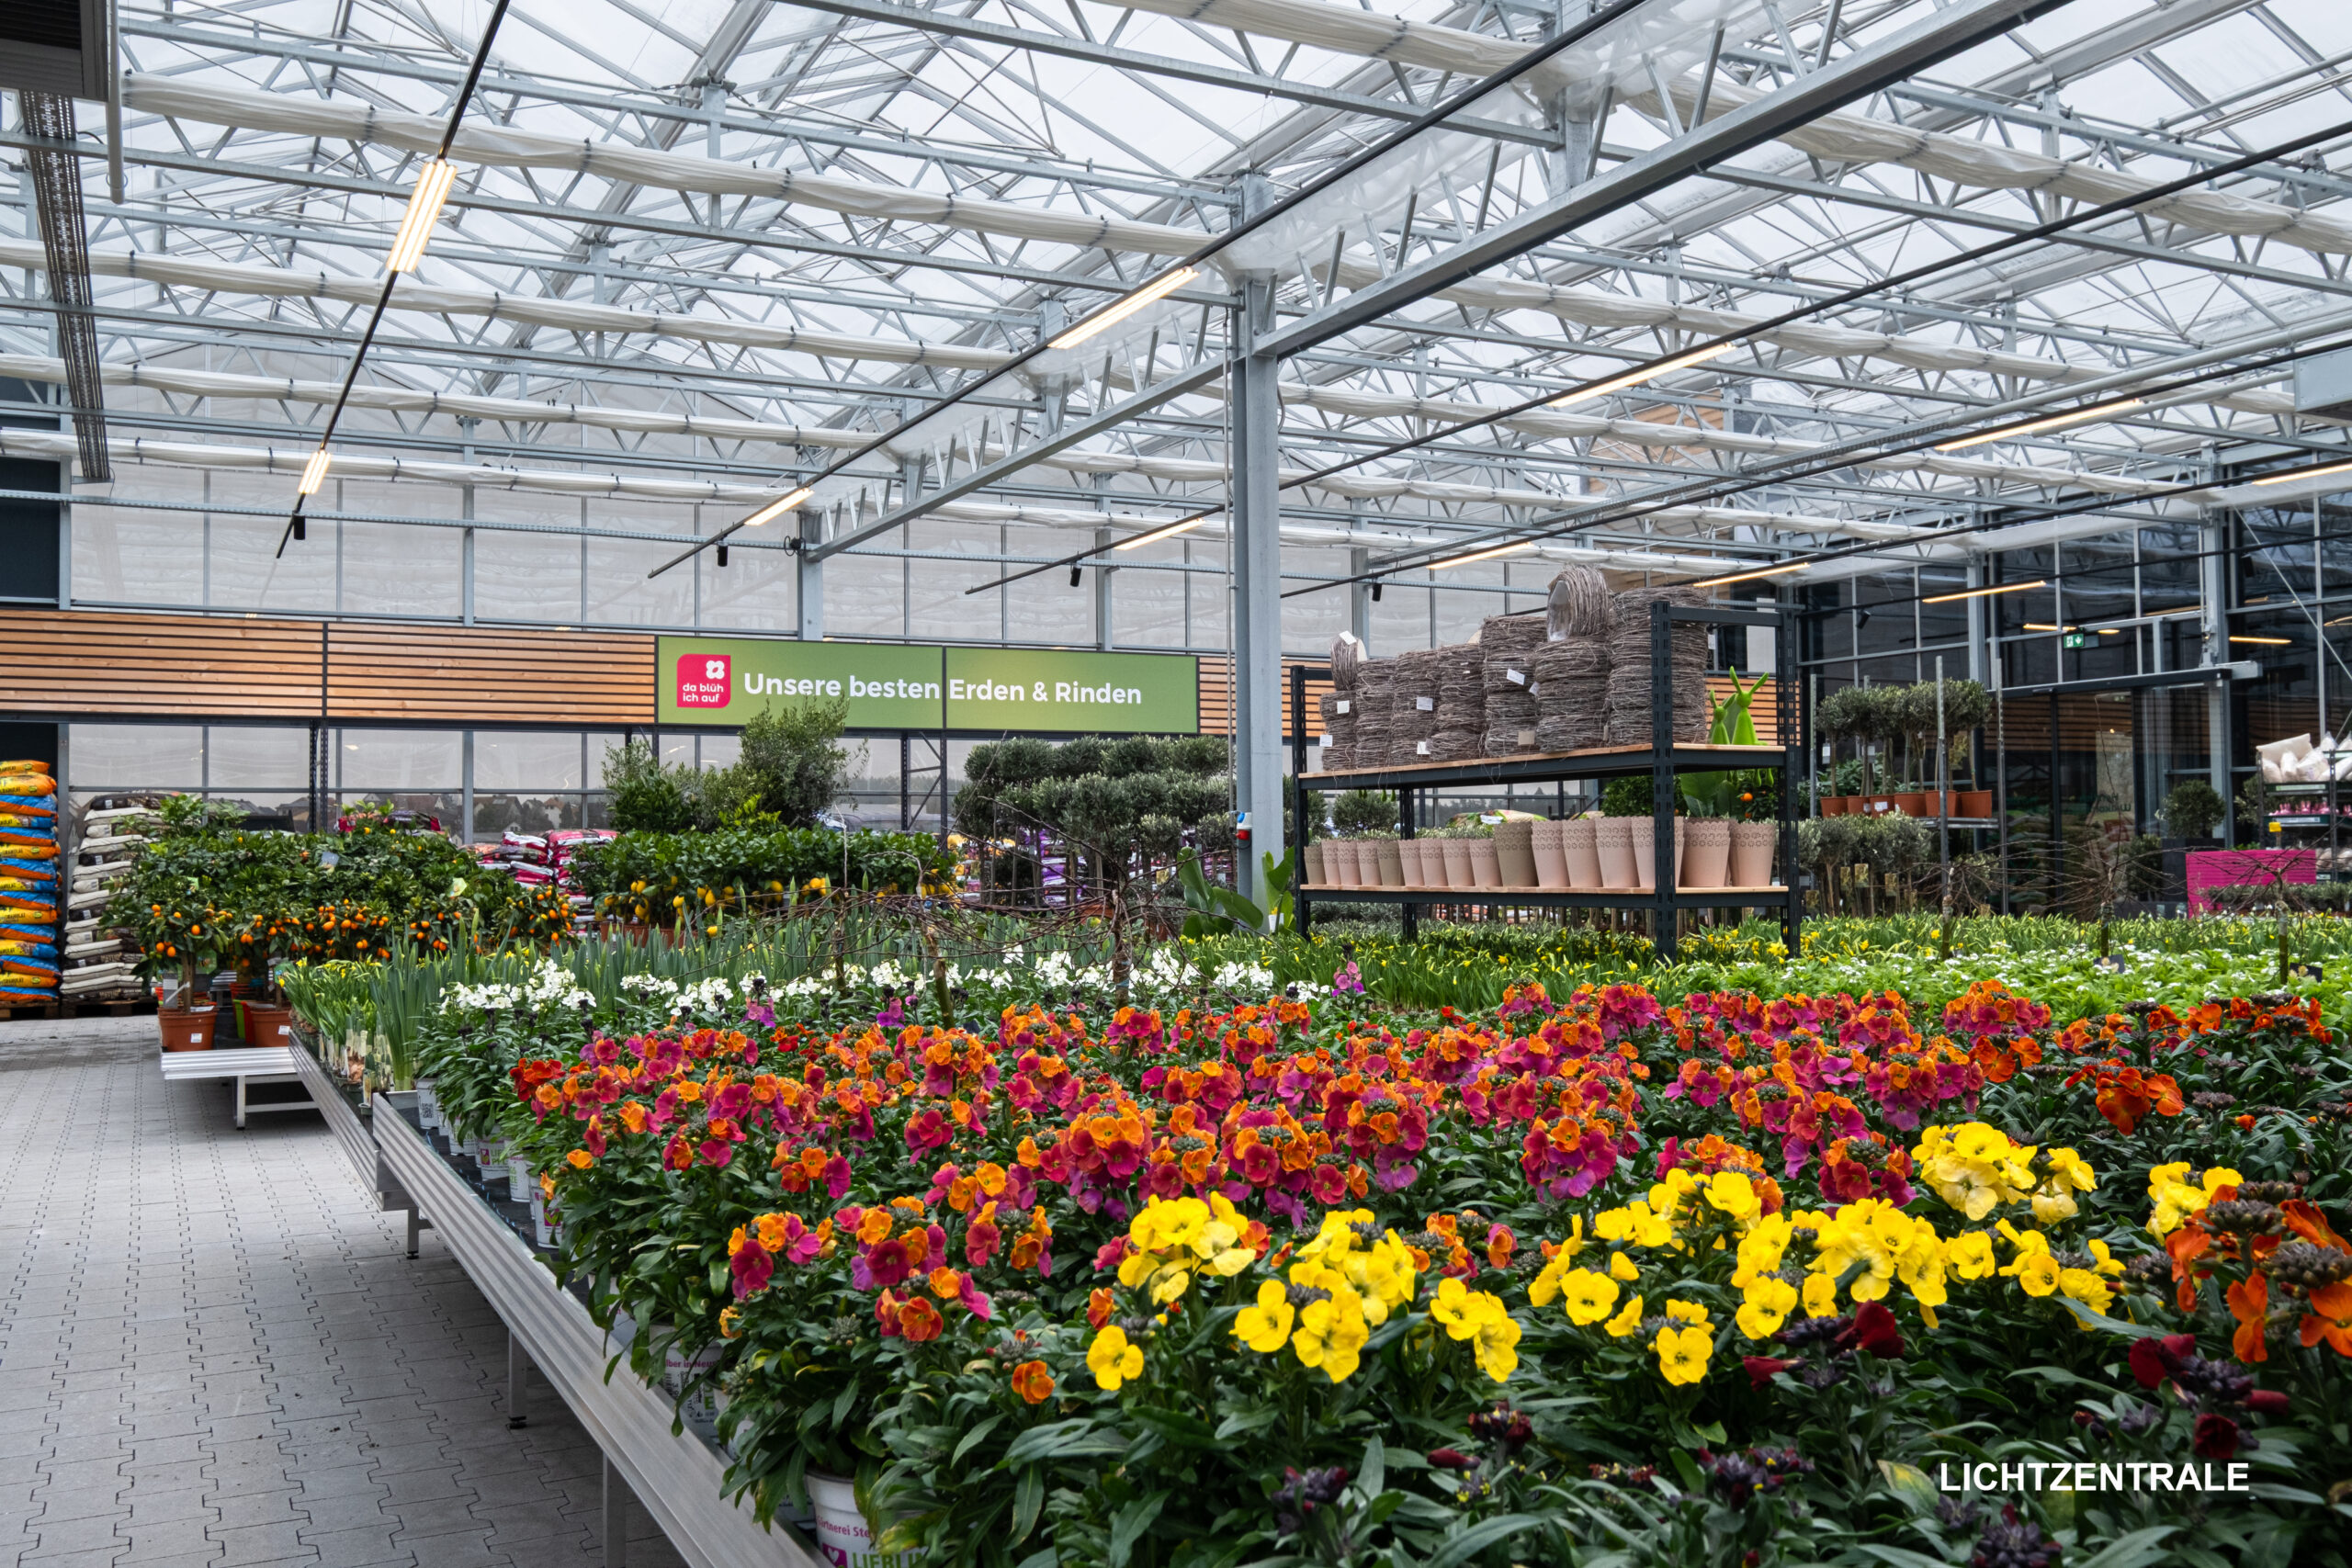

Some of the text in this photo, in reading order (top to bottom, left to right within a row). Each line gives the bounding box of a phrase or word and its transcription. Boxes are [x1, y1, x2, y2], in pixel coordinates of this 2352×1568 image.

[683, 682, 724, 693] da blüh
[744, 672, 1141, 705] Unsere besten Erden & Rinden
[683, 693, 719, 703] ich auf
[853, 1527, 870, 1538] Ste
